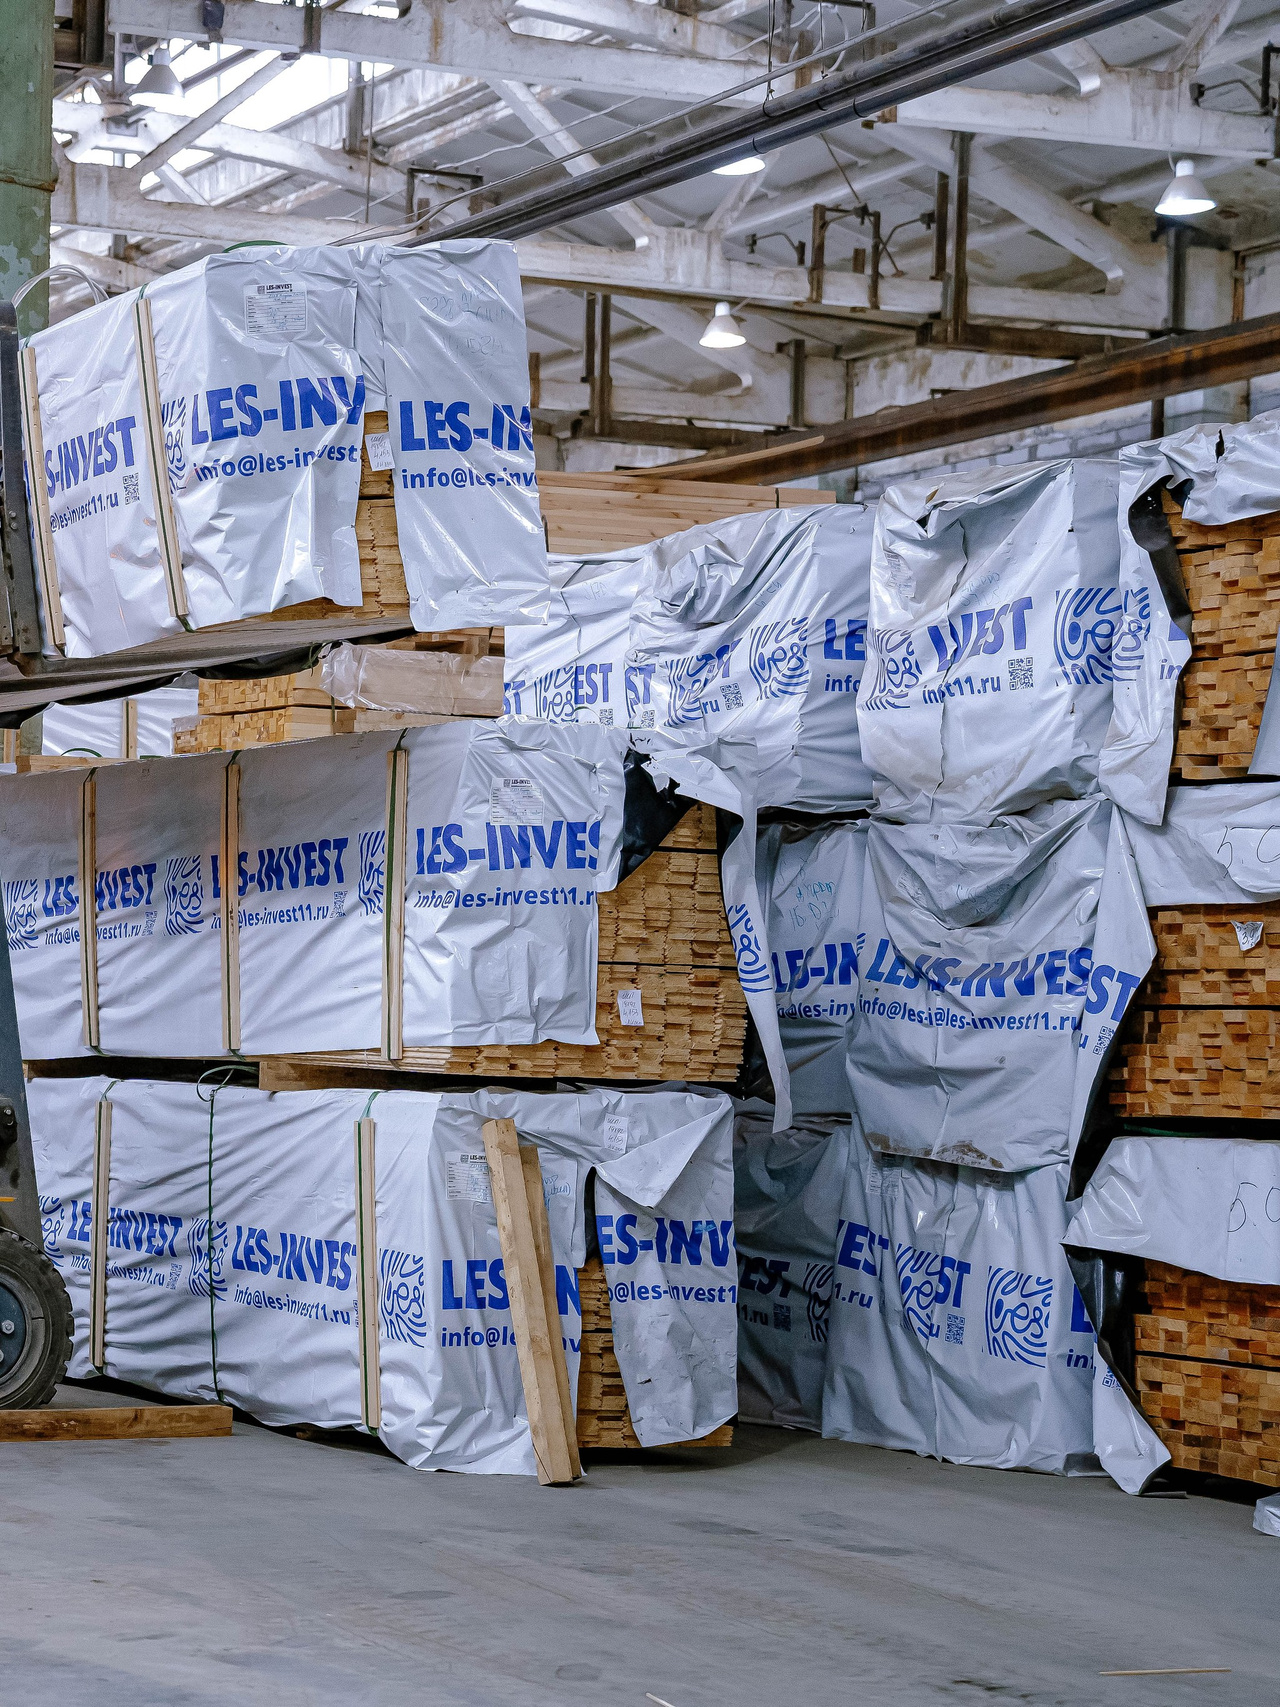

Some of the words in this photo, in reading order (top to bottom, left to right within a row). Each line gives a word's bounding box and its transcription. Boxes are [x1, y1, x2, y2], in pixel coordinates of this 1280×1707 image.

[266, 283, 293, 291] LES-INVEST
[42, 863, 157, 918] LES-NVEST
[210, 837, 349, 899] LS-INVEST
[66, 1199, 183, 1258] LE-INVEST
